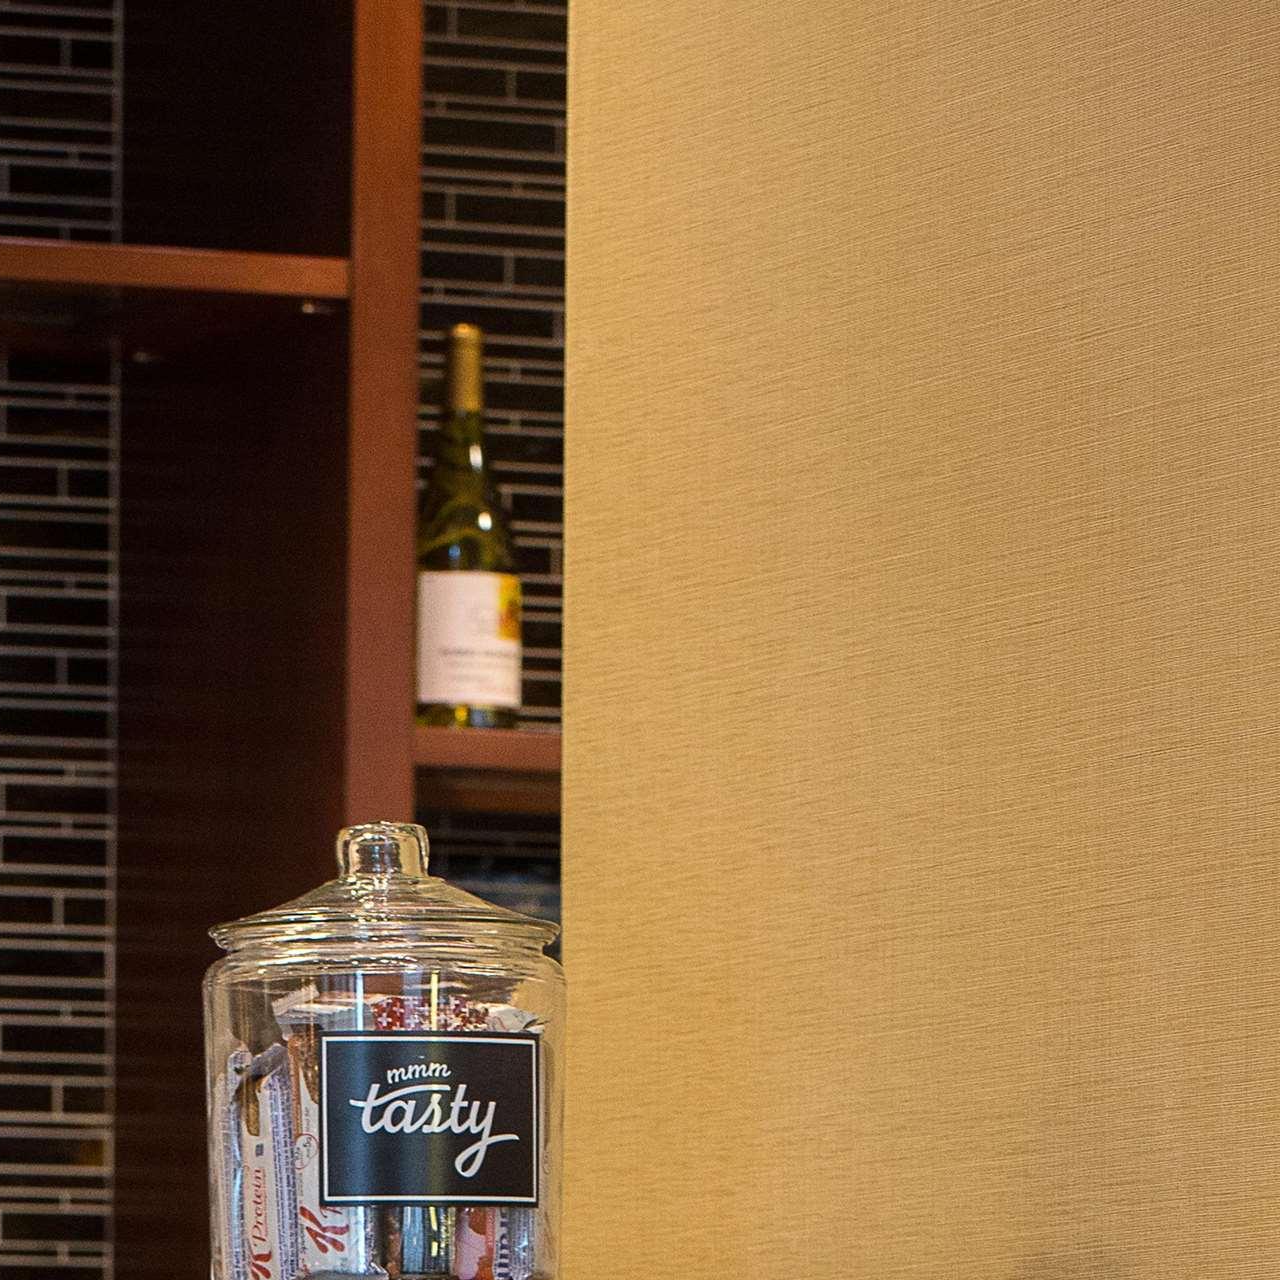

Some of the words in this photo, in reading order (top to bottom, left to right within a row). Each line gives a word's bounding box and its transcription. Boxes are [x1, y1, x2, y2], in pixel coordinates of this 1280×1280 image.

[386, 1062, 453, 1085] mmm
[349, 1083, 520, 1179] tasty
[251, 1168, 269, 1243] Protein
